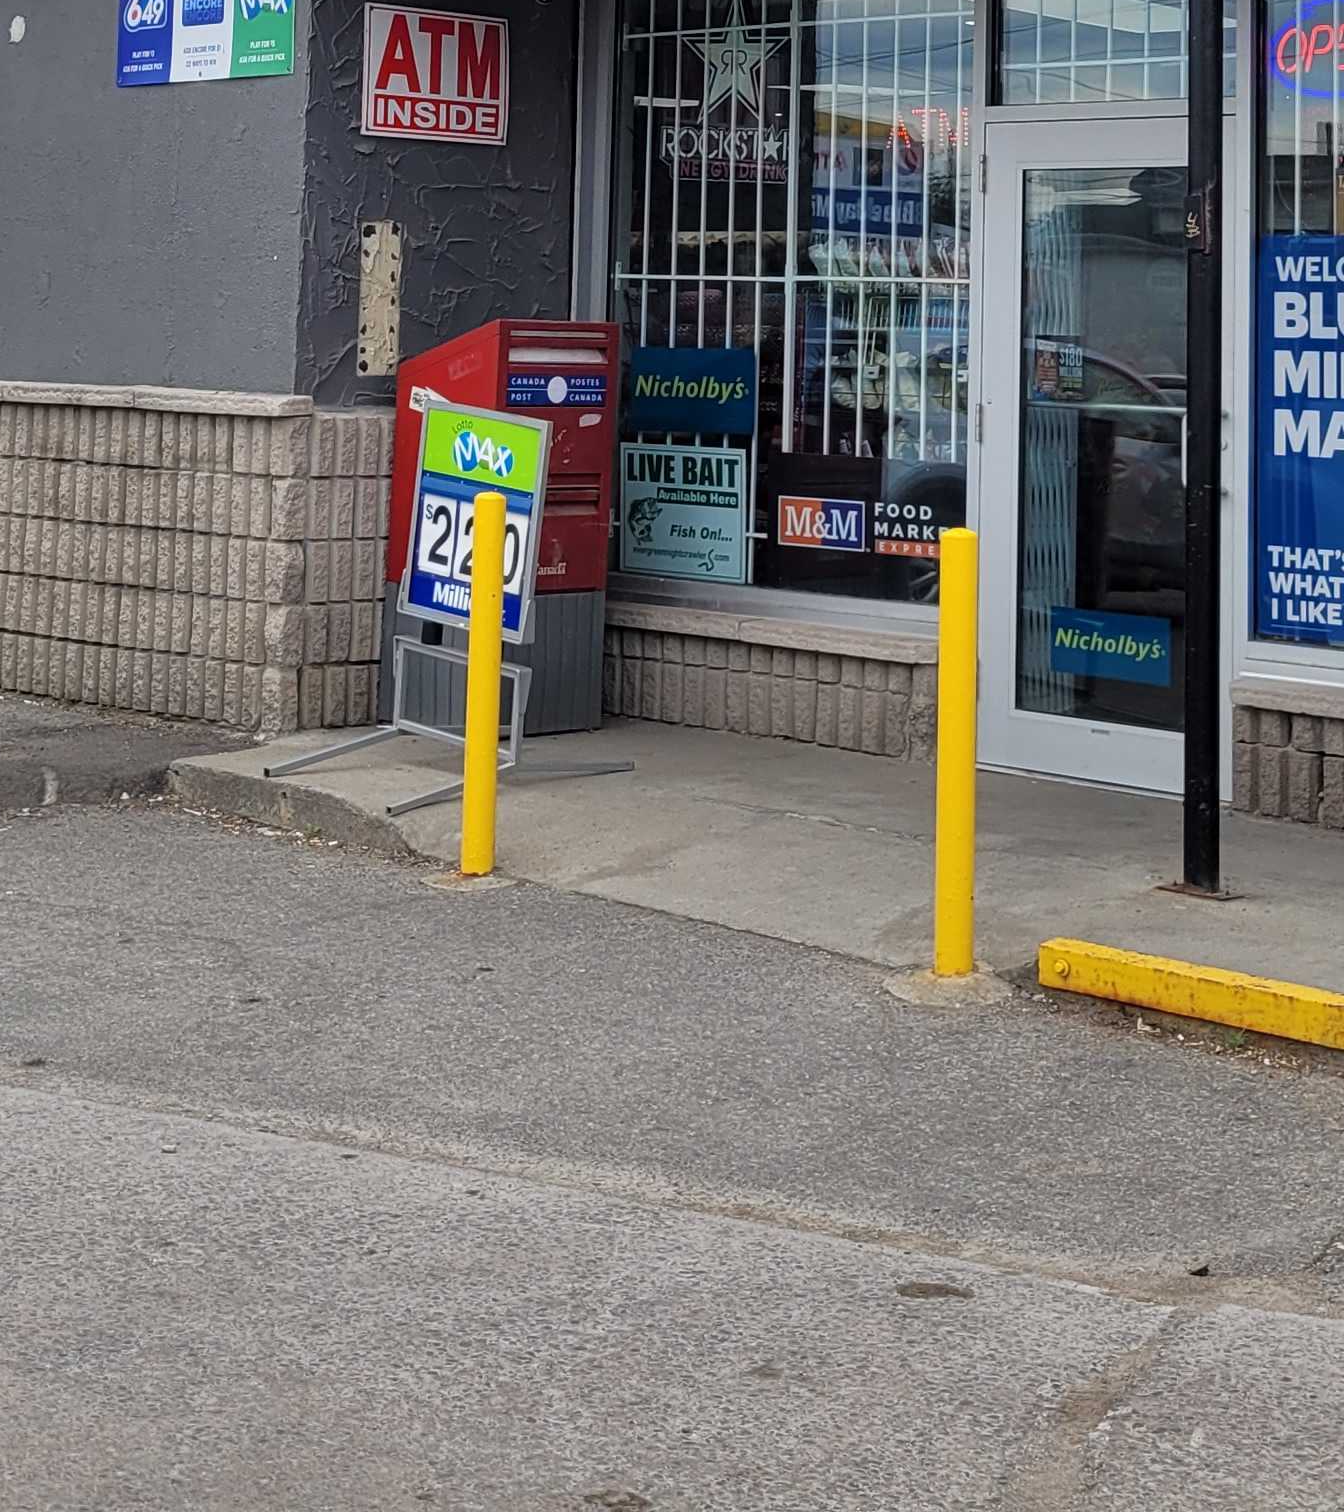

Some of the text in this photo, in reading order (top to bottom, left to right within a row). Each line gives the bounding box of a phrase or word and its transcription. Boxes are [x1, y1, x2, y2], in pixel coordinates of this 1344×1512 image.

[374, 13, 501, 100] ATM
[376, 97, 497, 134] INSIDE
[510, 377, 546, 387] CANADA
[570, 378, 600, 387] POSTES
[634, 374, 745, 406] Nicholby's
[510, 393, 532, 401] POST
[569, 393, 603, 402] CANADA
[453, 431, 513, 477] MAX
[626, 452, 740, 488] LIVE BAIT
[658, 489, 737, 506] Available Here
[874, 501, 932, 521] FOOD
[669, 524, 695, 539] Fish
[784, 505, 858, 542] M&M
[879, 543, 936, 555] EXPRE
[536, 562, 567, 576] anada
[1268, 571, 1344, 599] WHAT
[1270, 599, 1343, 626] I LIKE
[1054, 627, 1162, 662] Nicholby's
